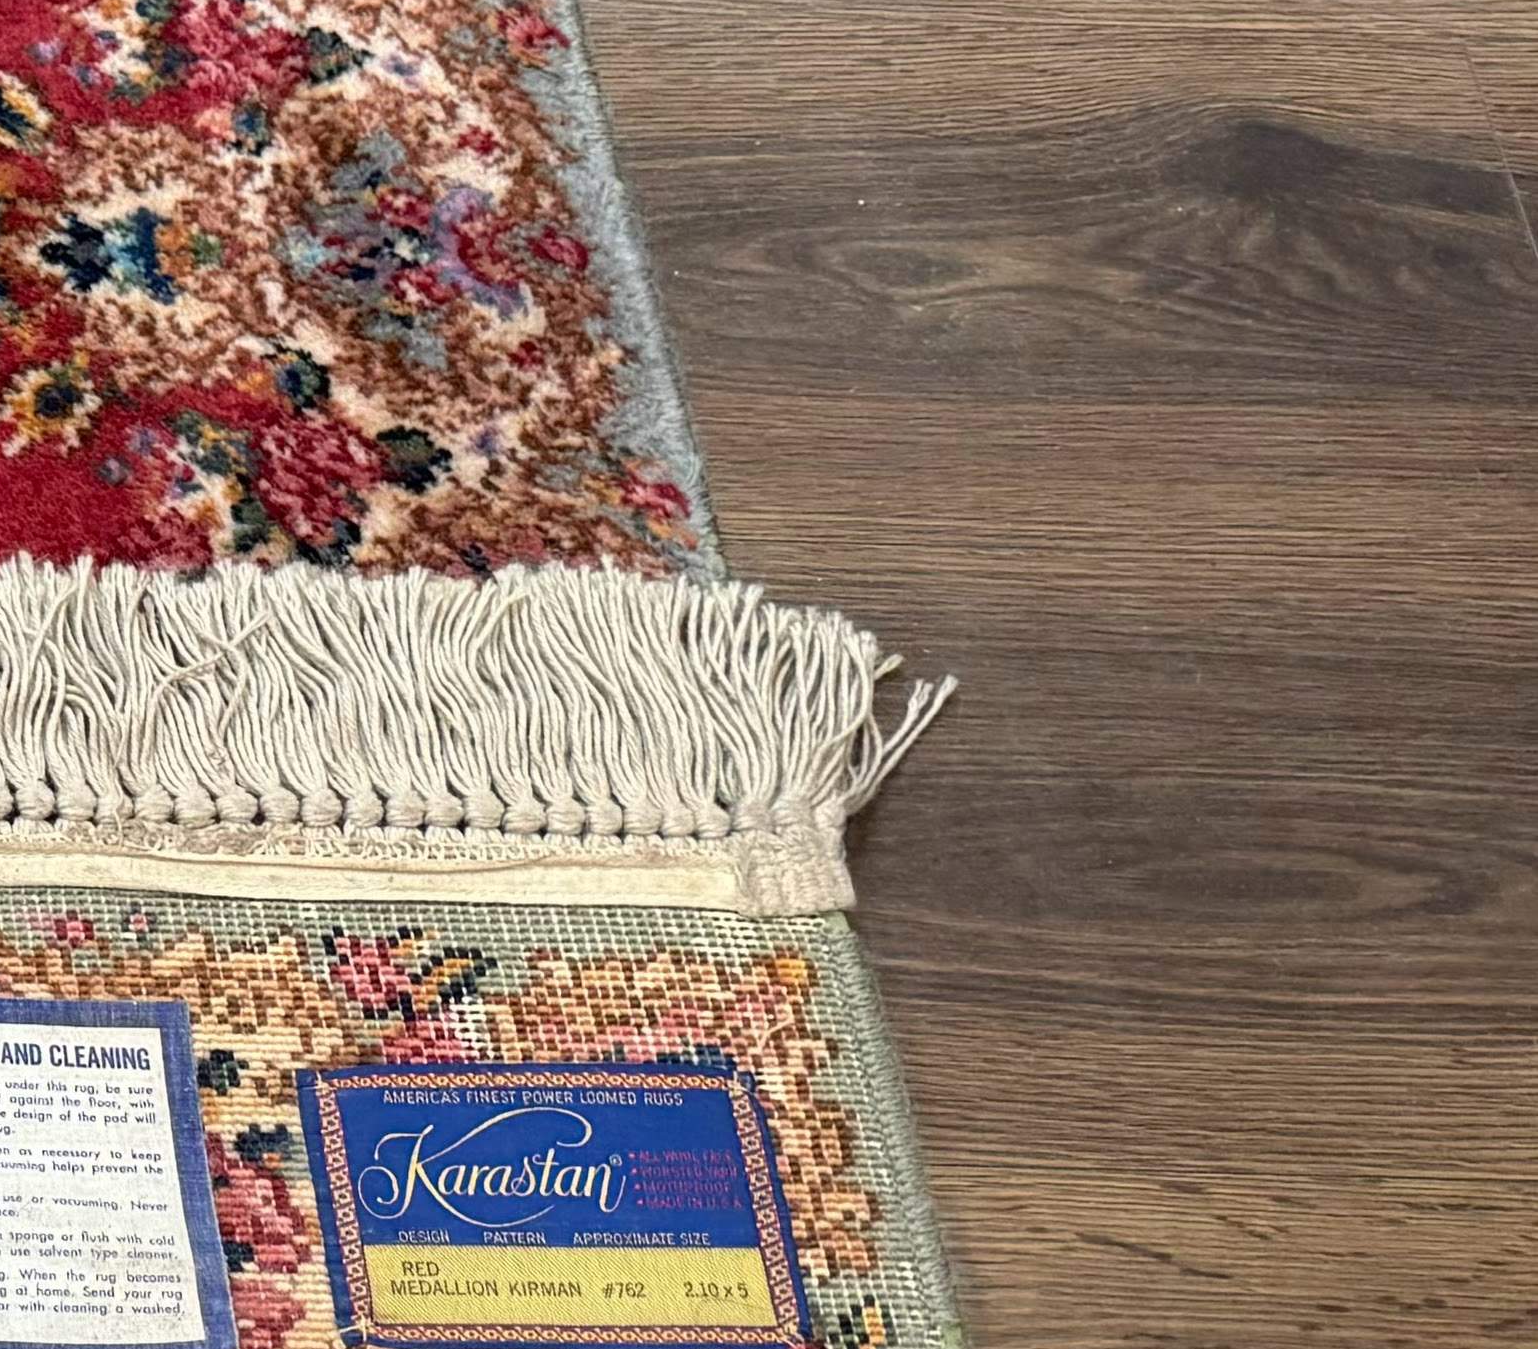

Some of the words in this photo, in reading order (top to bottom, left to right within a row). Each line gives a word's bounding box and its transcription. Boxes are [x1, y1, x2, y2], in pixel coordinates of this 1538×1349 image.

[0, 1041, 43, 1066] AND
[48, 1043, 151, 1071] CLEANING
[4, 1078, 39, 1089] under
[46, 1080, 67, 1090] this
[127, 1085, 153, 1094] sure
[8, 1093, 54, 1108] against
[61, 1095, 81, 1105] the
[128, 1097, 154, 1108] with
[466, 1090, 516, 1105] FINEST
[522, 1090, 573, 1106] POWER
[580, 1090, 637, 1106] LOOMED
[644, 1090, 684, 1106] RUGS
[13, 1108, 53, 1123] design
[77, 1111, 97, 1121] the
[102, 1112, 129, 1126] pad
[134, 1113, 156, 1124] will
[41, 1148, 101, 1162] necessary
[130, 1150, 162, 1164] keep
[51, 1160, 85, 1175] helps
[91, 1163, 138, 1177] prevent
[144, 1163, 163, 1174] the
[358, 1107, 626, 1227] Karastan
[2, 1194, 22, 1202] use
[130, 1199, 168, 1211] Never
[9, 1231, 55, 1244] sponge
[80, 1230, 109, 1242] flush
[115, 1232, 142, 1243] with
[148, 1234, 175, 1245] cold
[398, 1229, 450, 1244] DESIGN
[483, 1231, 546, 1245] PATTERN
[573, 1232, 676, 1246] APPROXIMATE
[680, 1232, 711, 1246] SIZE
[9, 1247, 30, 1256] use
[90, 1247, 119, 1261] type
[18, 1268, 56, 1279] When
[65, 1269, 85, 1280] the
[95, 1272, 117, 1285] rug
[125, 1271, 181, 1283] becomes
[401, 1261, 440, 1277] RED
[82, 1286, 115, 1297] Send
[123, 1289, 152, 1302] your
[160, 1290, 183, 1302] rug
[391, 1280, 499, 1297] MEDALLION
[509, 1282, 583, 1298] KIRMAN
[604, 1282, 647, 1299] #762
[685, 1281, 719, 1298] 2.10
[738, 1282, 749, 1299] 5
[17, 1299, 45, 1311] with
[52, 1301, 108, 1317] cleaning
